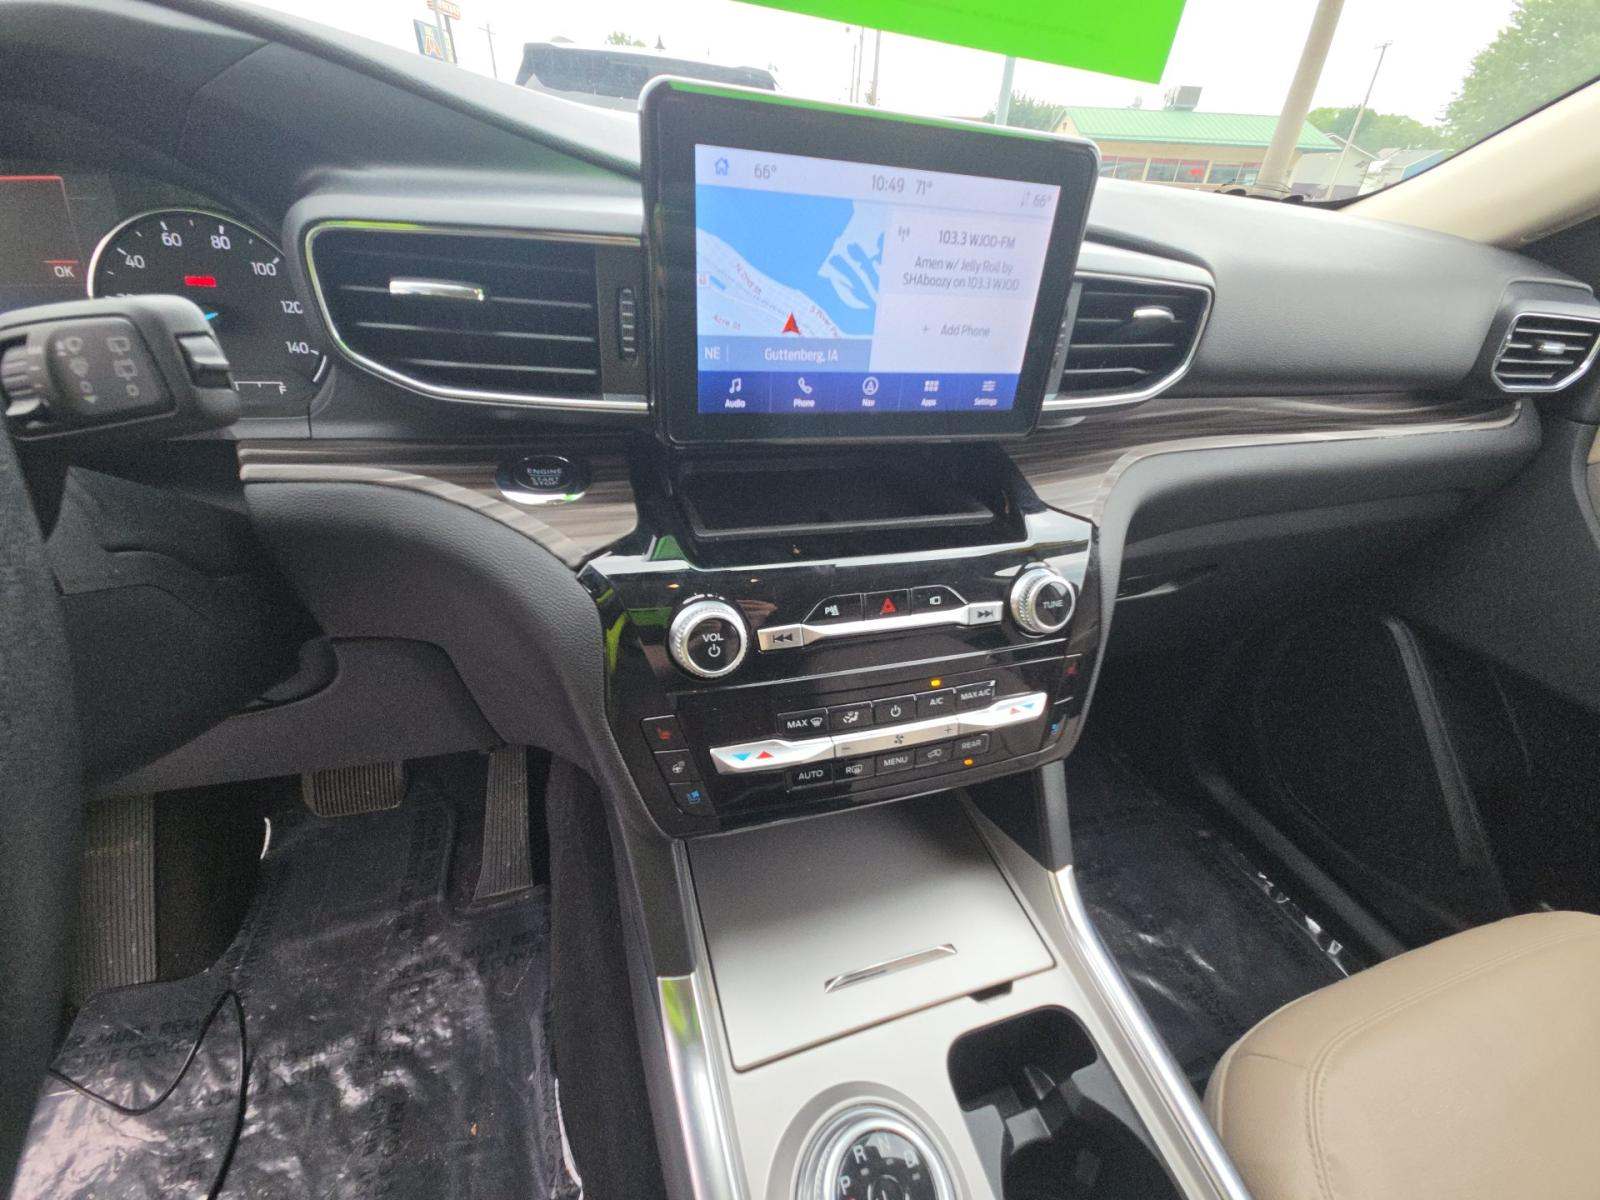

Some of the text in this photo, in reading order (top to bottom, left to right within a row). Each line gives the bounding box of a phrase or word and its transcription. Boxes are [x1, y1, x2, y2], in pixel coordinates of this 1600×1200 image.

[872, 174, 905, 193] 10:49
[161, 232, 182, 247] 60
[210, 234, 231, 250] 80
[938, 229, 968, 246] 103.3
[125, 254, 145, 269] 40
[914, 255, 944, 270] Amen
[54, 265, 74, 278] OK
[250, 261, 277, 277] 100
[952, 276, 967, 288] on
[940, 322, 990, 338] Add Phone
[285, 340, 310, 355] 140
[704, 346, 839, 364] NE Guttenberg, IA
[279, 384, 288, 396] F
[724, 398, 747, 409] Audio
[793, 398, 816, 408] Phone
[862, 398, 876, 407] Nav
[920, 397, 938, 408] Apps
[526, 466, 562, 475] ENGINE
[1042, 599, 1064, 609] TUNE
[702, 632, 725, 643] VOL
[929, 697, 943, 706] A/C
[960, 691, 979, 701] MAX
[786, 719, 808, 729] MAX
[961, 739, 982, 749] REAR
[883, 756, 908, 767] MENU
[798, 769, 824, 780] AUTO
[853, 1144, 867, 1164] R
[838, 1175, 851, 1196] P
